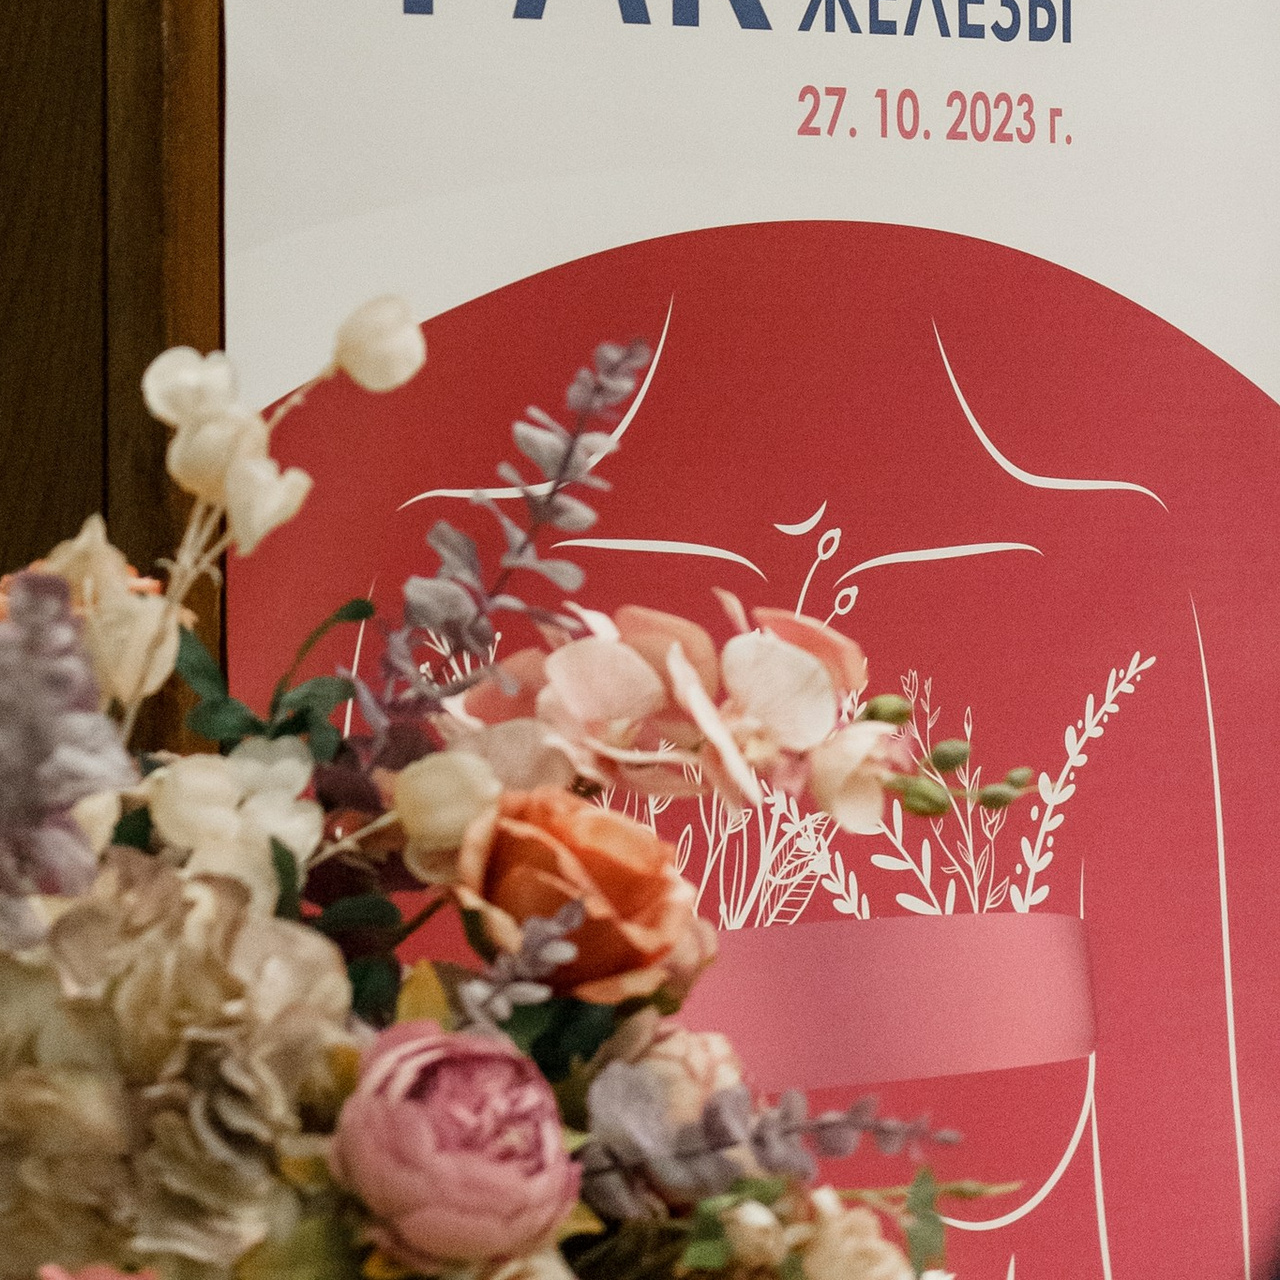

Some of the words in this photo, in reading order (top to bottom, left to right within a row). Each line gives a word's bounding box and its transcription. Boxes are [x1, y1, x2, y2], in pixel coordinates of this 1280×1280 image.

[797, 85, 858, 139] 27.
[875, 88, 932, 141] 10.
[946, 90, 1036, 144] 2023
[1048, 107, 1075, 145] г.
